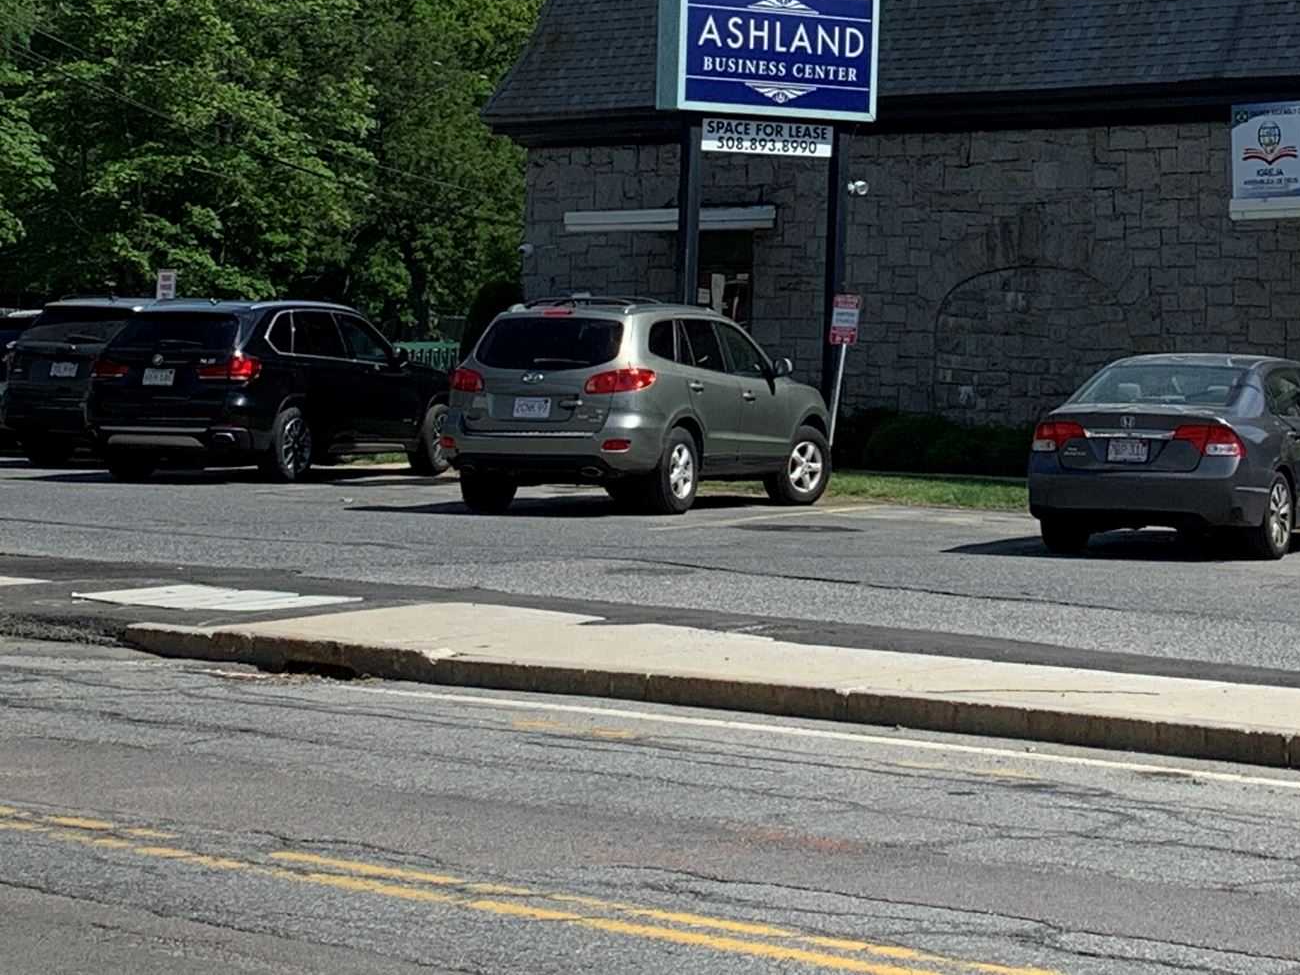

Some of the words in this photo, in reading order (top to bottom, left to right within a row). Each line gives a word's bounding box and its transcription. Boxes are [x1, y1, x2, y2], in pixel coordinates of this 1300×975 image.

[698, 15, 864, 57] ASHLAND
[703, 56, 787, 76] BUSINESS
[792, 64, 857, 82] CENTER
[707, 121, 750, 136] SPACE
[756, 123, 784, 137] FOR
[789, 125, 827, 139] LEASE
[716, 137, 817, 154] 508.893.8990
